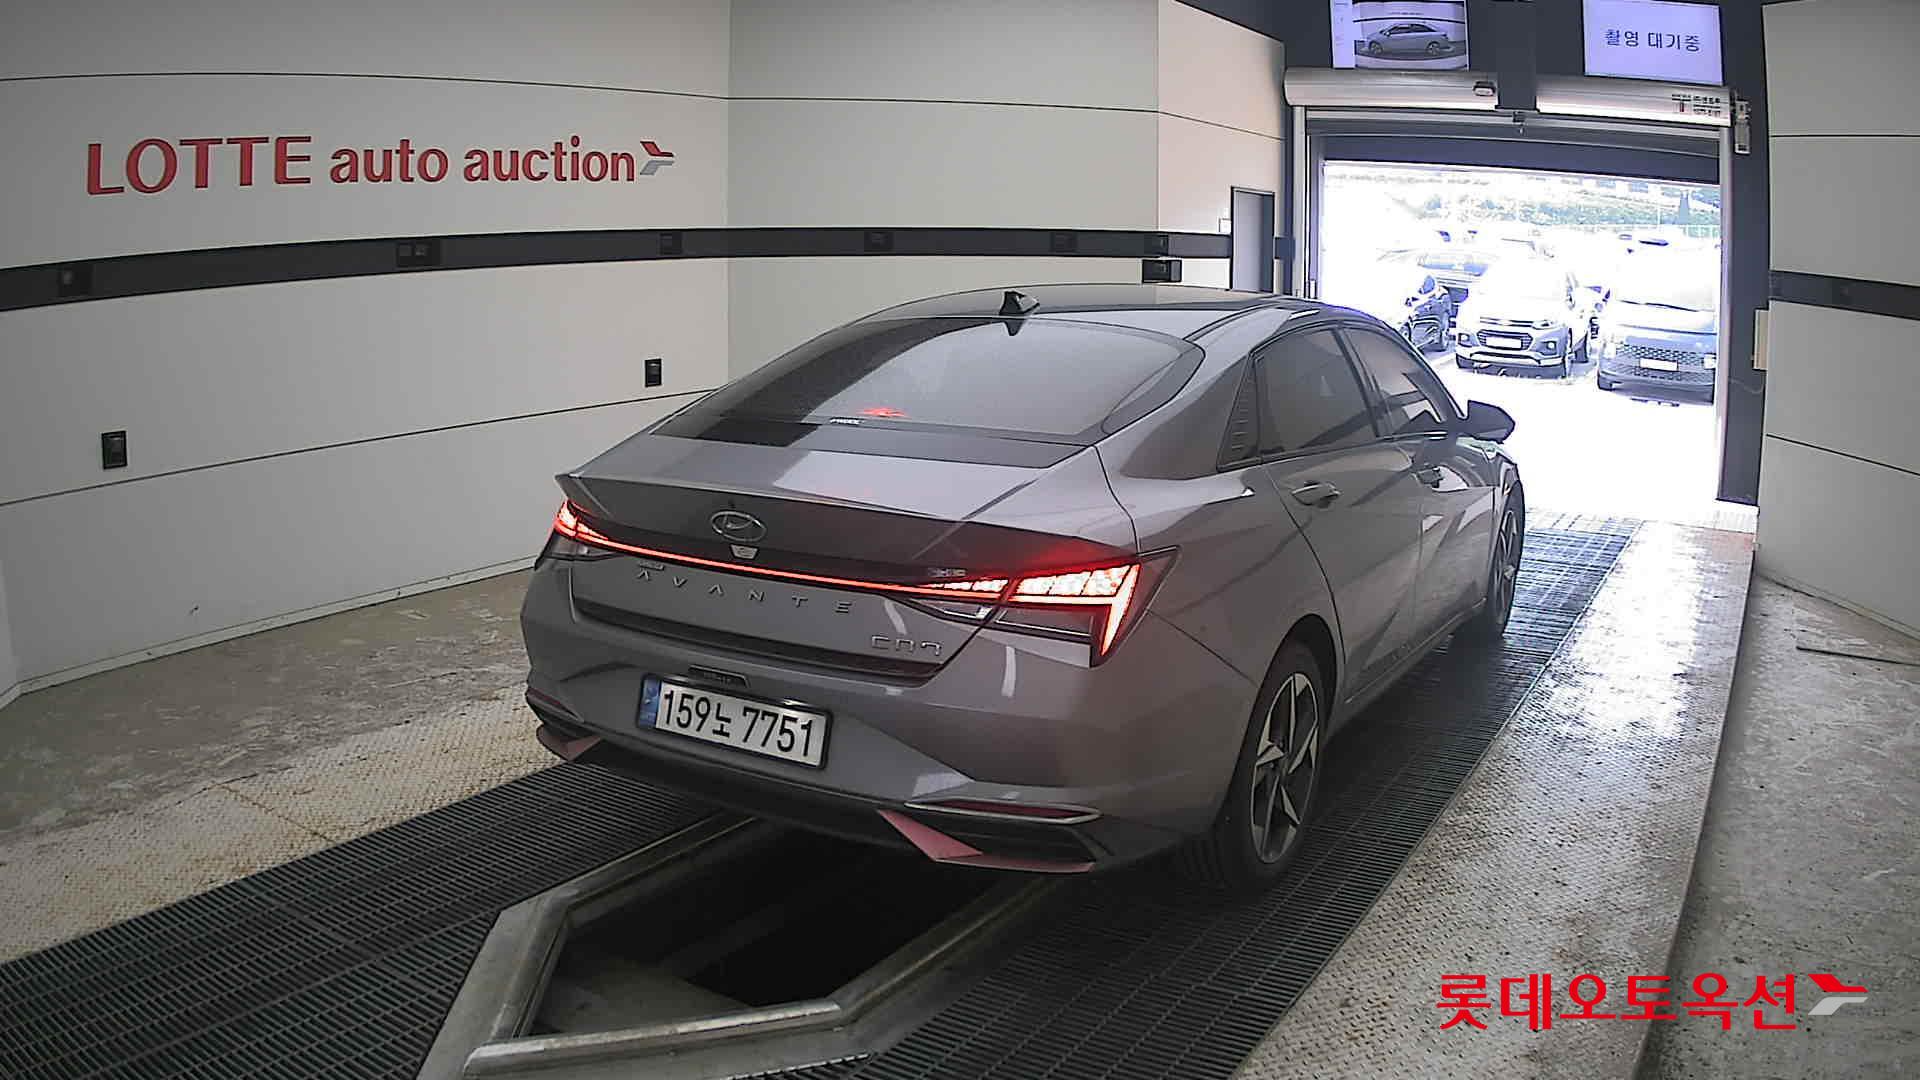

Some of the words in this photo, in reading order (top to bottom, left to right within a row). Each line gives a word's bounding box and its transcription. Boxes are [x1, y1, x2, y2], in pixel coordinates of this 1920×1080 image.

[1605, 29, 1639, 47] 촬영
[1647, 32, 1701, 52] 대기중
[87, 136, 312, 195] LOTTE
[330, 139, 449, 183] auto
[463, 135, 635, 182] auction
[637, 568, 852, 614] AVANTE
